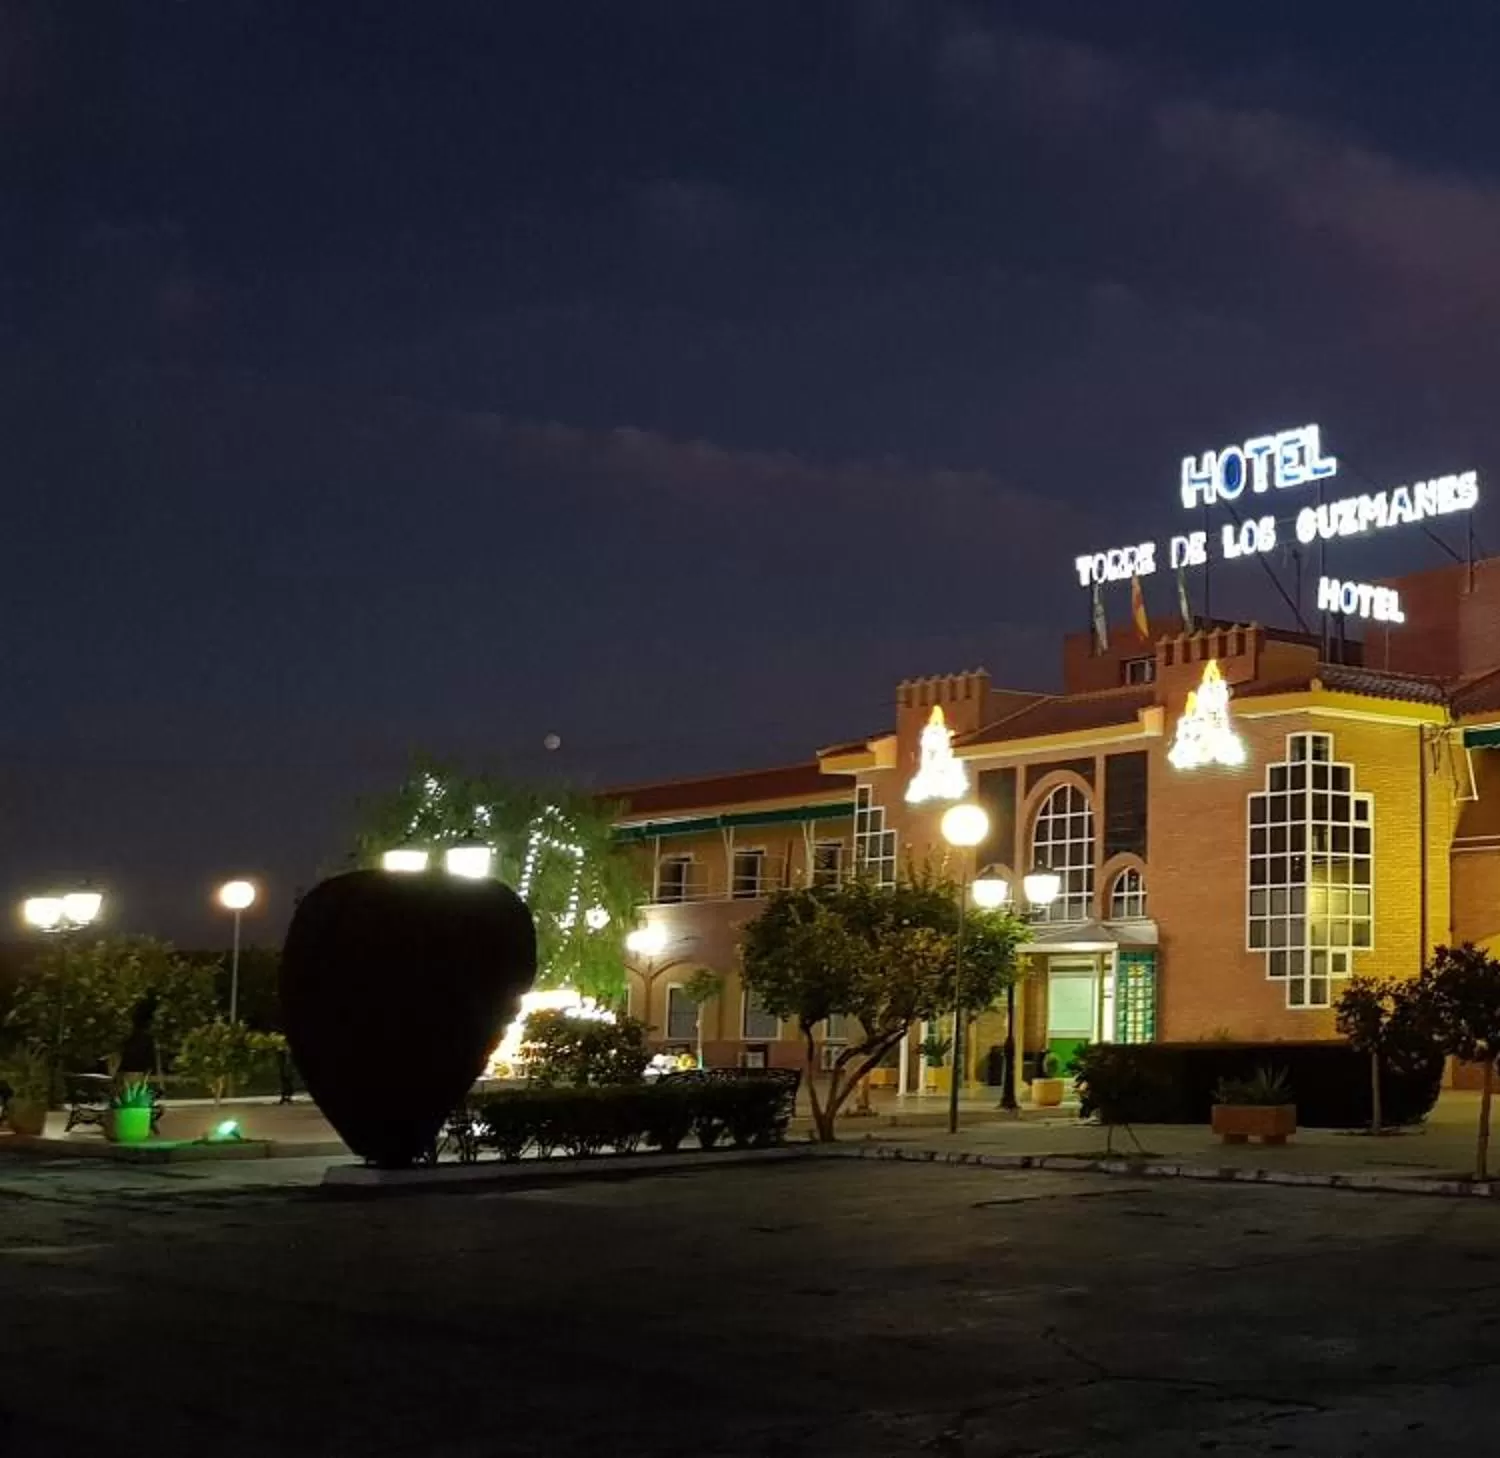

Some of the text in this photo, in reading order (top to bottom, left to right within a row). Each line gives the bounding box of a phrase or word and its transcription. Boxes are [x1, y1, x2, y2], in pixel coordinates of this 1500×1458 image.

[1181, 424, 1337, 508] HOTEL
[1075, 470, 1479, 586] TORRE DE LOS GUZMANES
[1318, 575, 1405, 624] HOTEL
